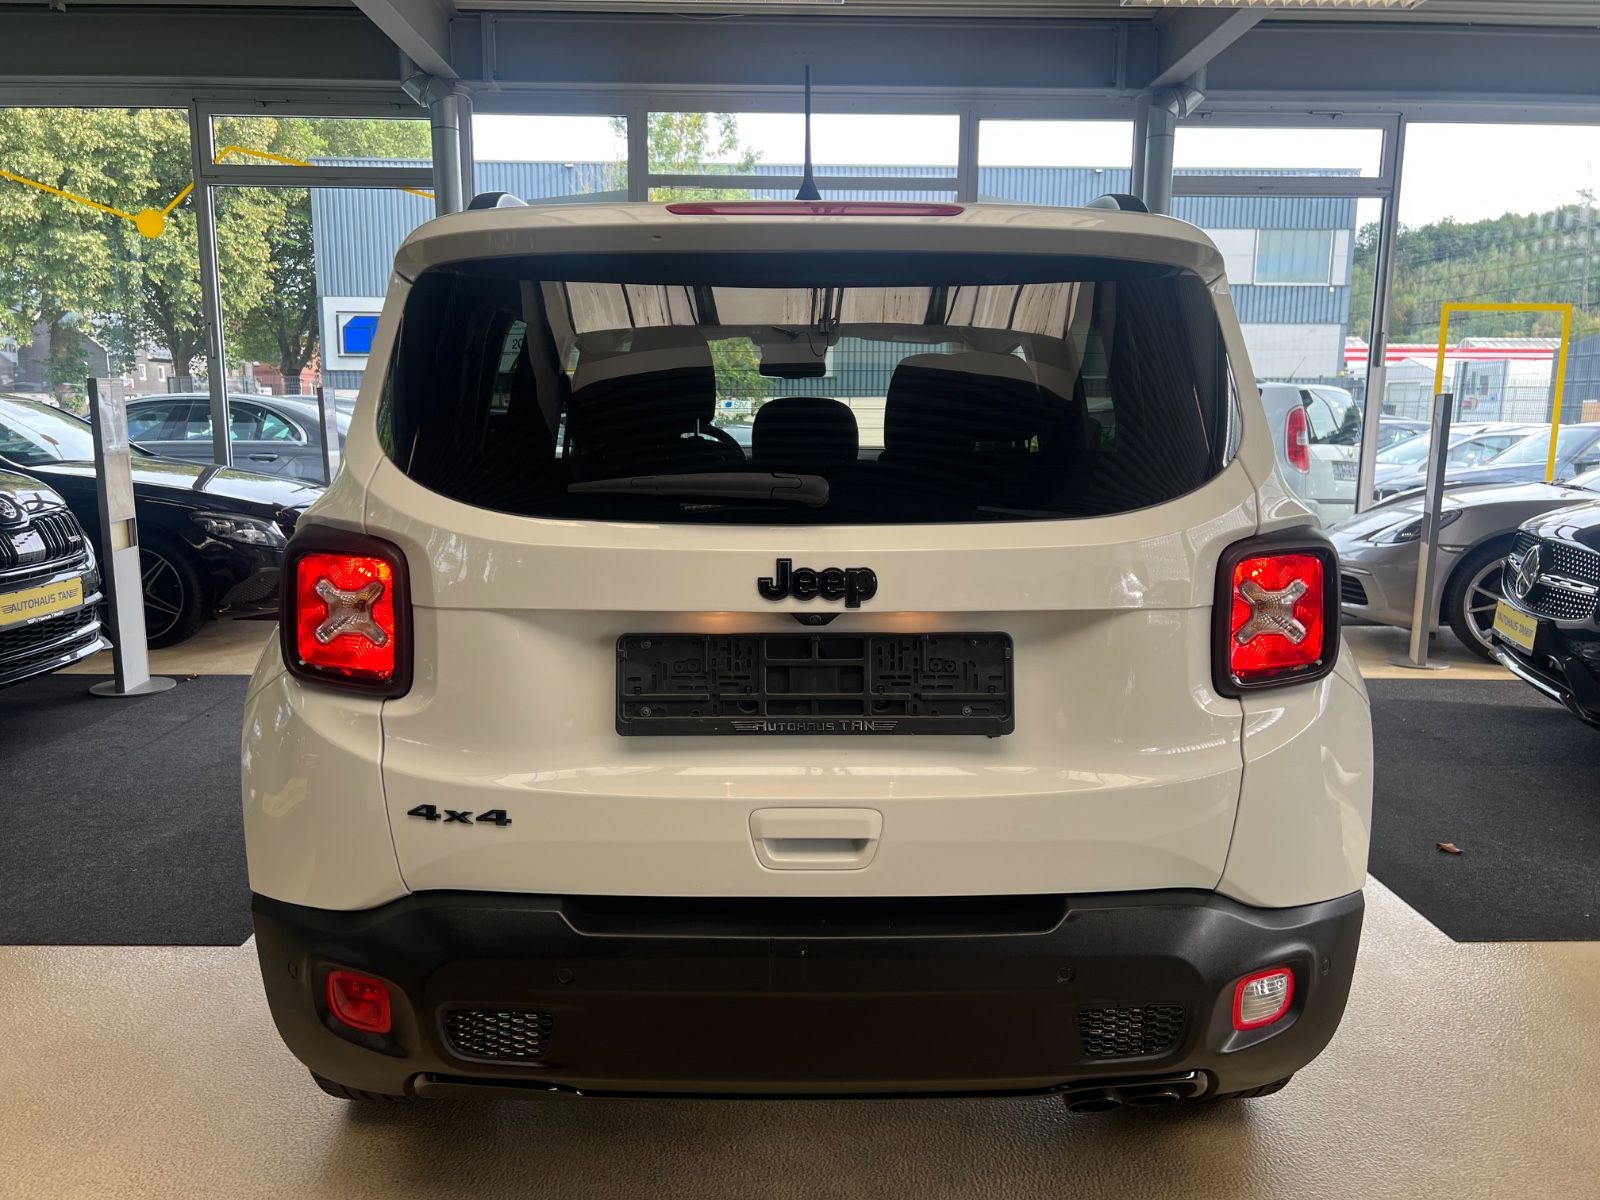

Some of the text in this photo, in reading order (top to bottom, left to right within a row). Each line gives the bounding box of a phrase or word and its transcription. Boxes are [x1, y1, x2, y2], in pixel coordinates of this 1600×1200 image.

[757, 558, 878, 608] Jeep
[11, 590, 73, 613] AUTOHAUS TAN
[838, 720, 875, 732] TAN
[407, 804, 512, 826] 4x4
